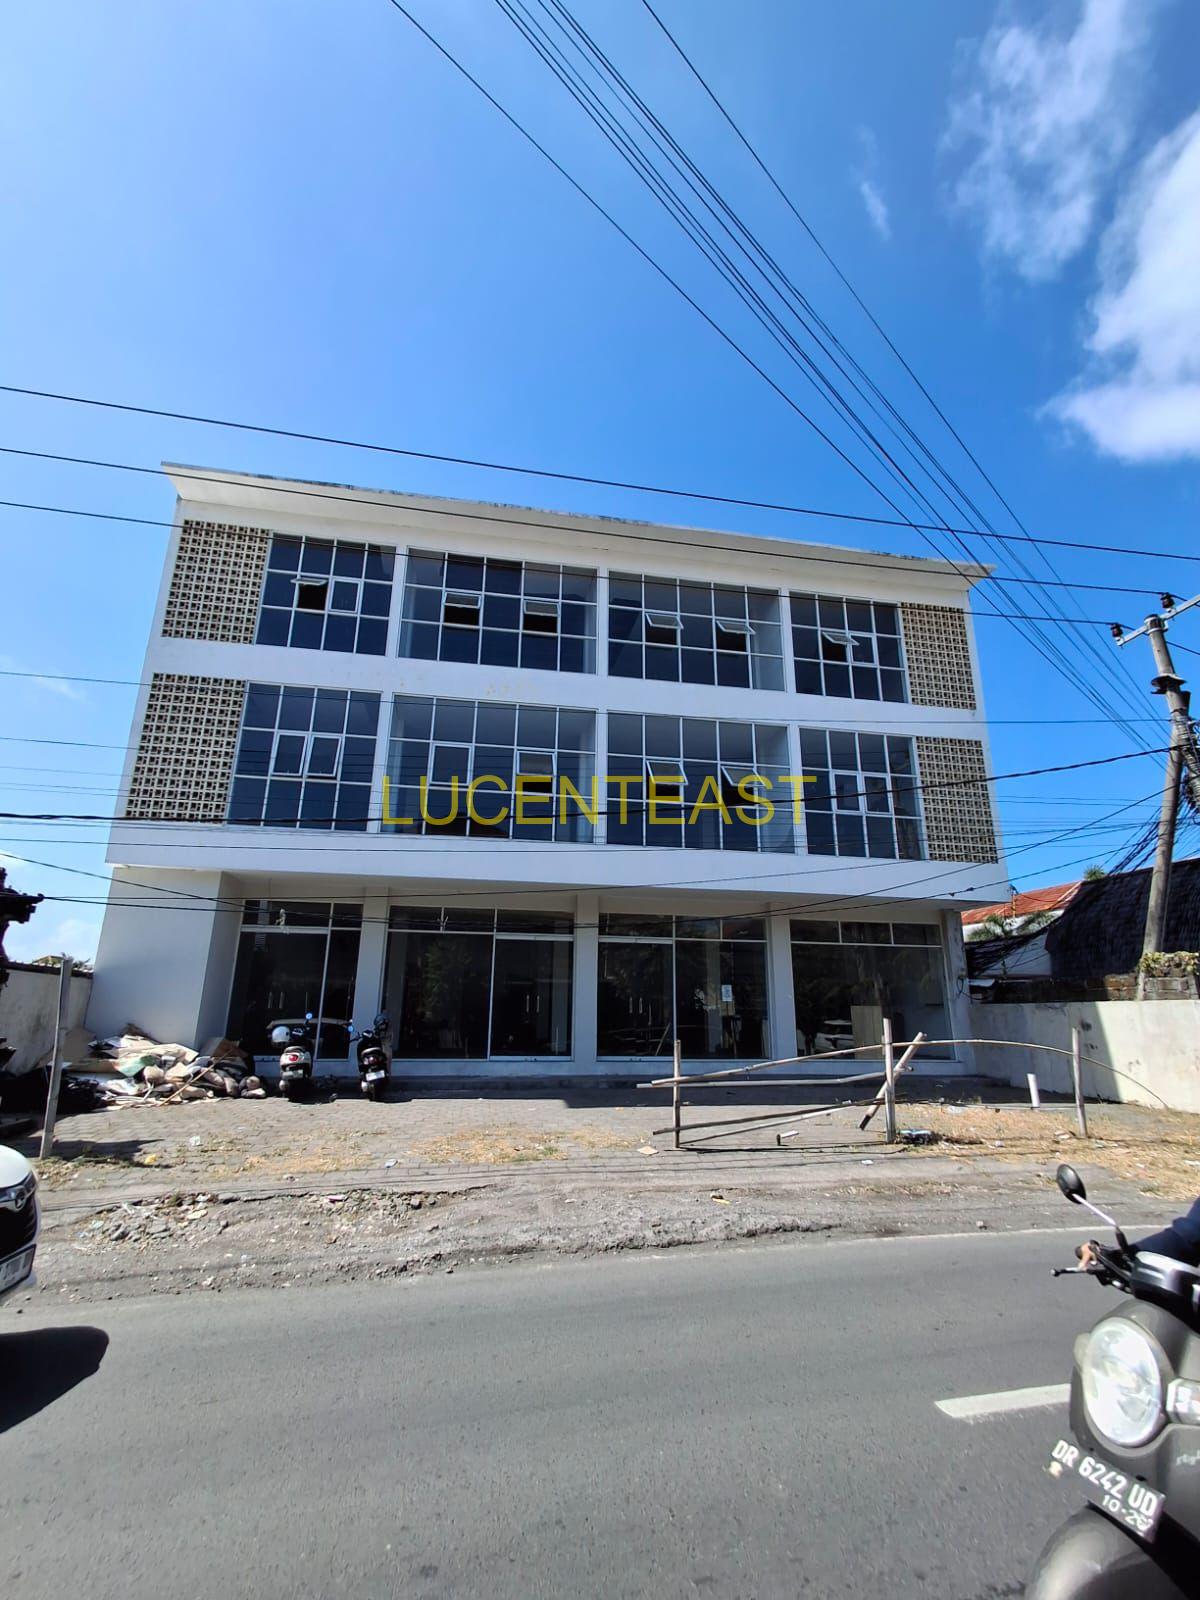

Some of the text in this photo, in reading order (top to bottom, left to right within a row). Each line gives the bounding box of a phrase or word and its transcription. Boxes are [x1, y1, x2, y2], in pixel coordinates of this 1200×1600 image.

[1051, 1439, 1158, 1517] DR 6242 UD
